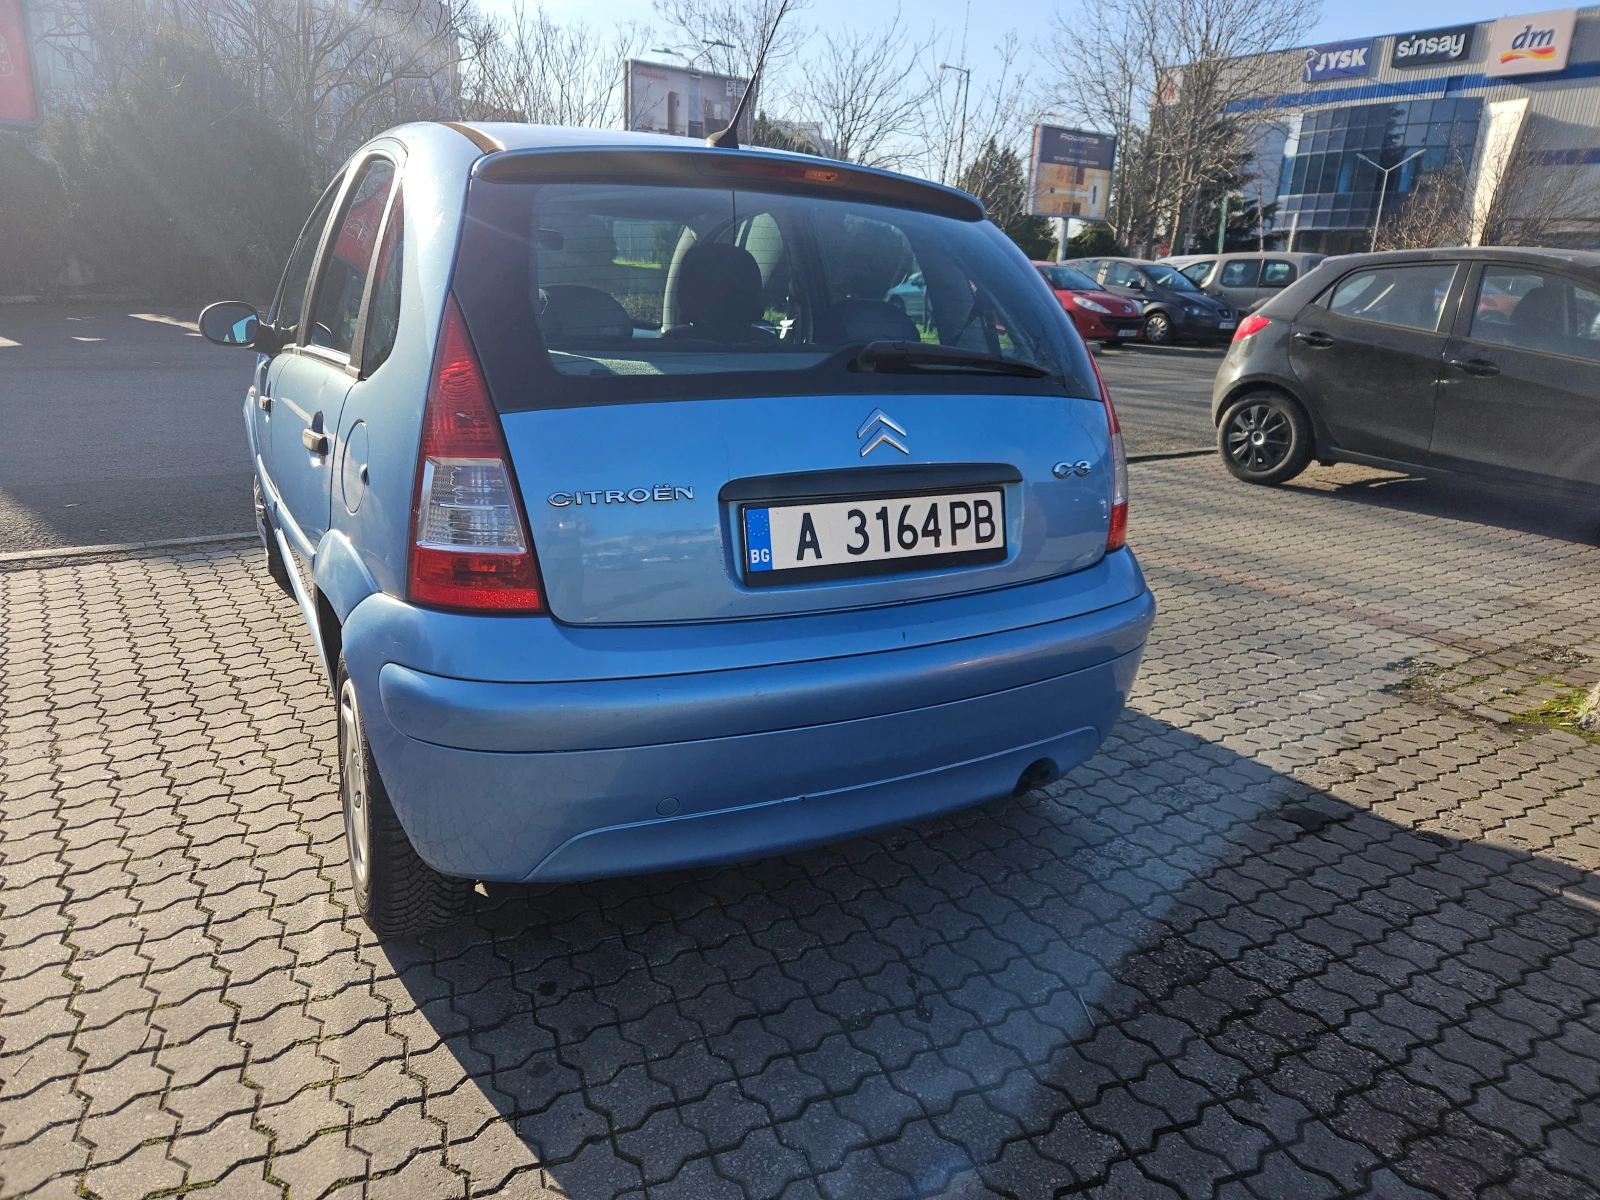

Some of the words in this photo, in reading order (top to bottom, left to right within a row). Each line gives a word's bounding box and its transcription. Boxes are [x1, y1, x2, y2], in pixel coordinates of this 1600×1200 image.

[1396, 33, 1466, 58] sinsay
[1511, 24, 1556, 50] dm
[1315, 47, 1368, 72] JYSK
[634, 70, 669, 81] GRUNDIG
[547, 483, 694, 507] CITROËN
[751, 549, 770, 564] BG
